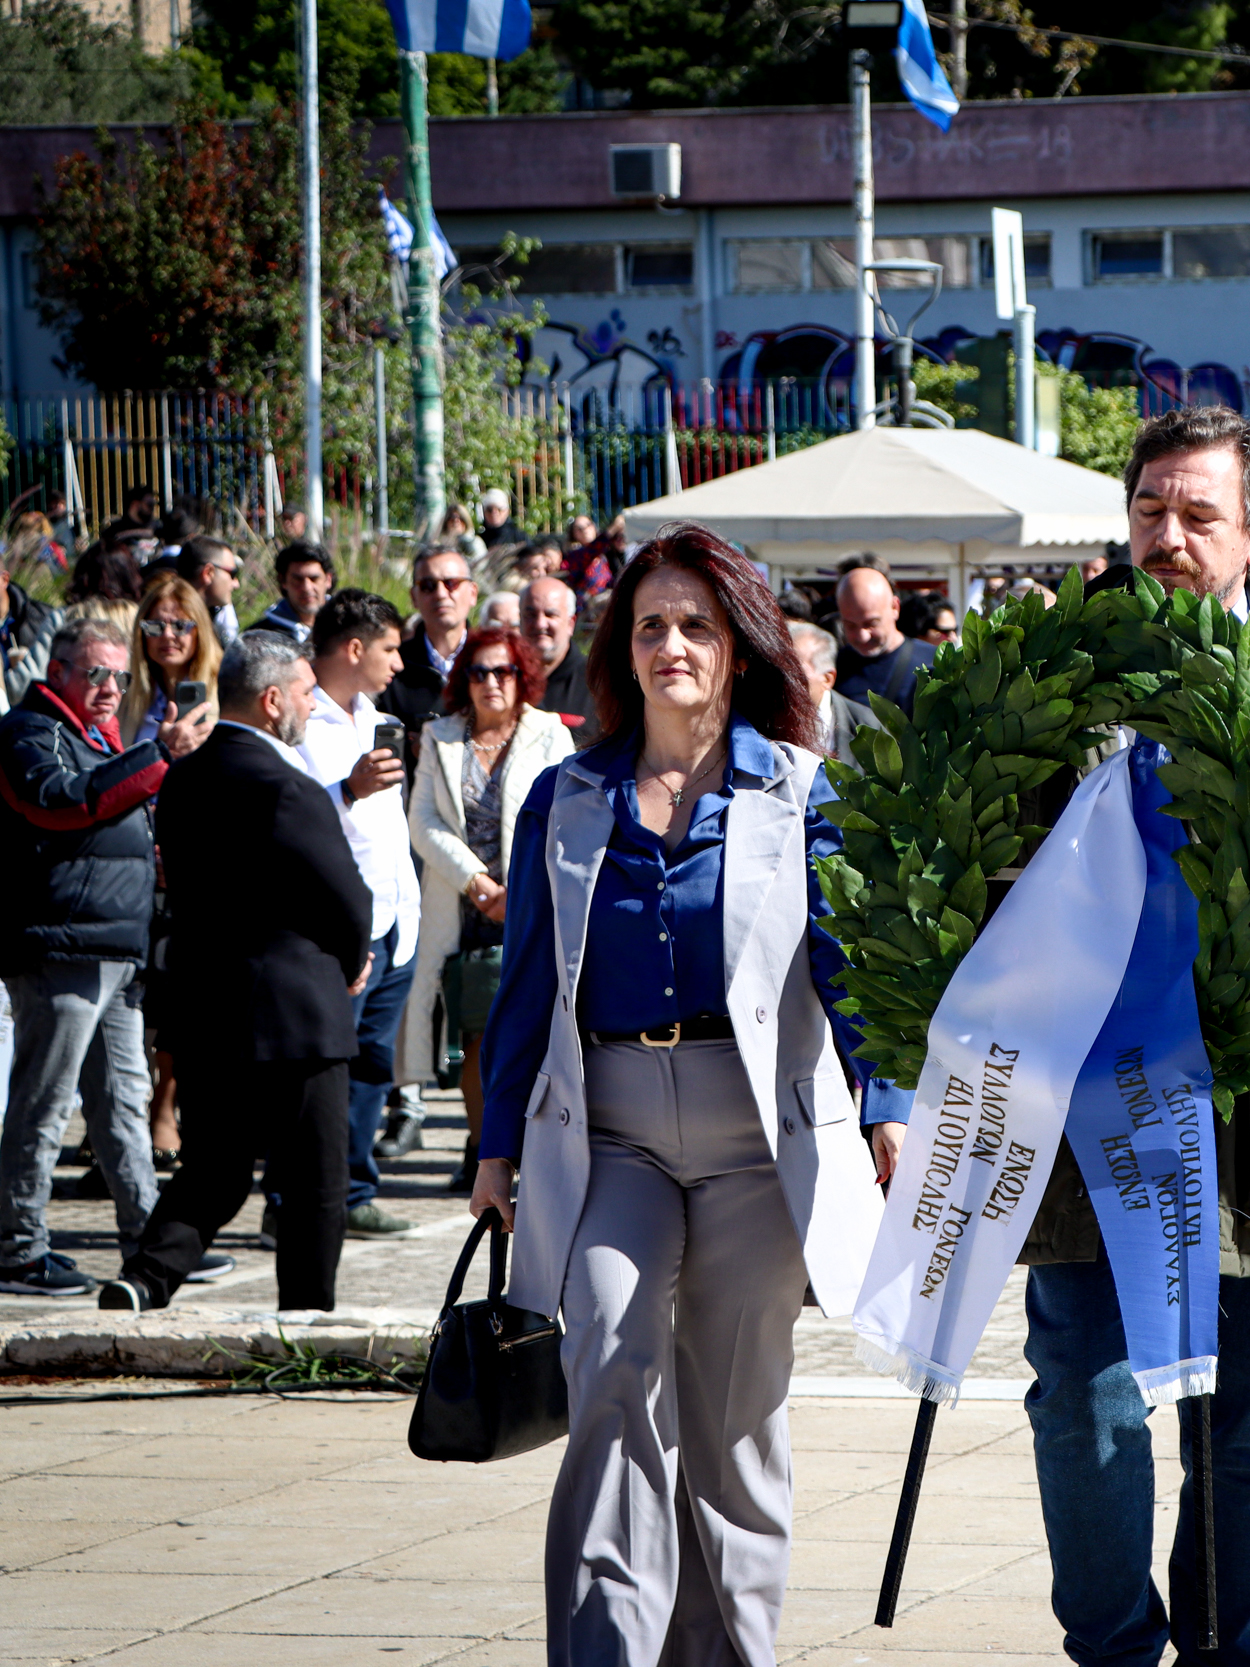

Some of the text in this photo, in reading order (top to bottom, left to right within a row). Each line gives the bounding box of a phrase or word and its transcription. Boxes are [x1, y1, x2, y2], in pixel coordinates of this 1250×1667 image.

[911, 1074, 975, 1235] ΗΛΙΟΥΠΟΛΗΣ
[918, 1042, 1020, 1304] ΣΥΛΛΟΓΩΝ ΓΟΝΕΩΝ
[981, 1140, 1036, 1227] ΕΝΩΣΗ
[1099, 1132, 1152, 1211] ΕΝΩΣΗ
[1113, 1044, 1181, 1307] ΣΥΛΛΟΓΩΝ ΓΟΝΕΩΝ
[1161, 1083, 1203, 1247] ΗΛΙΟΥΠΟΛΗΣ
